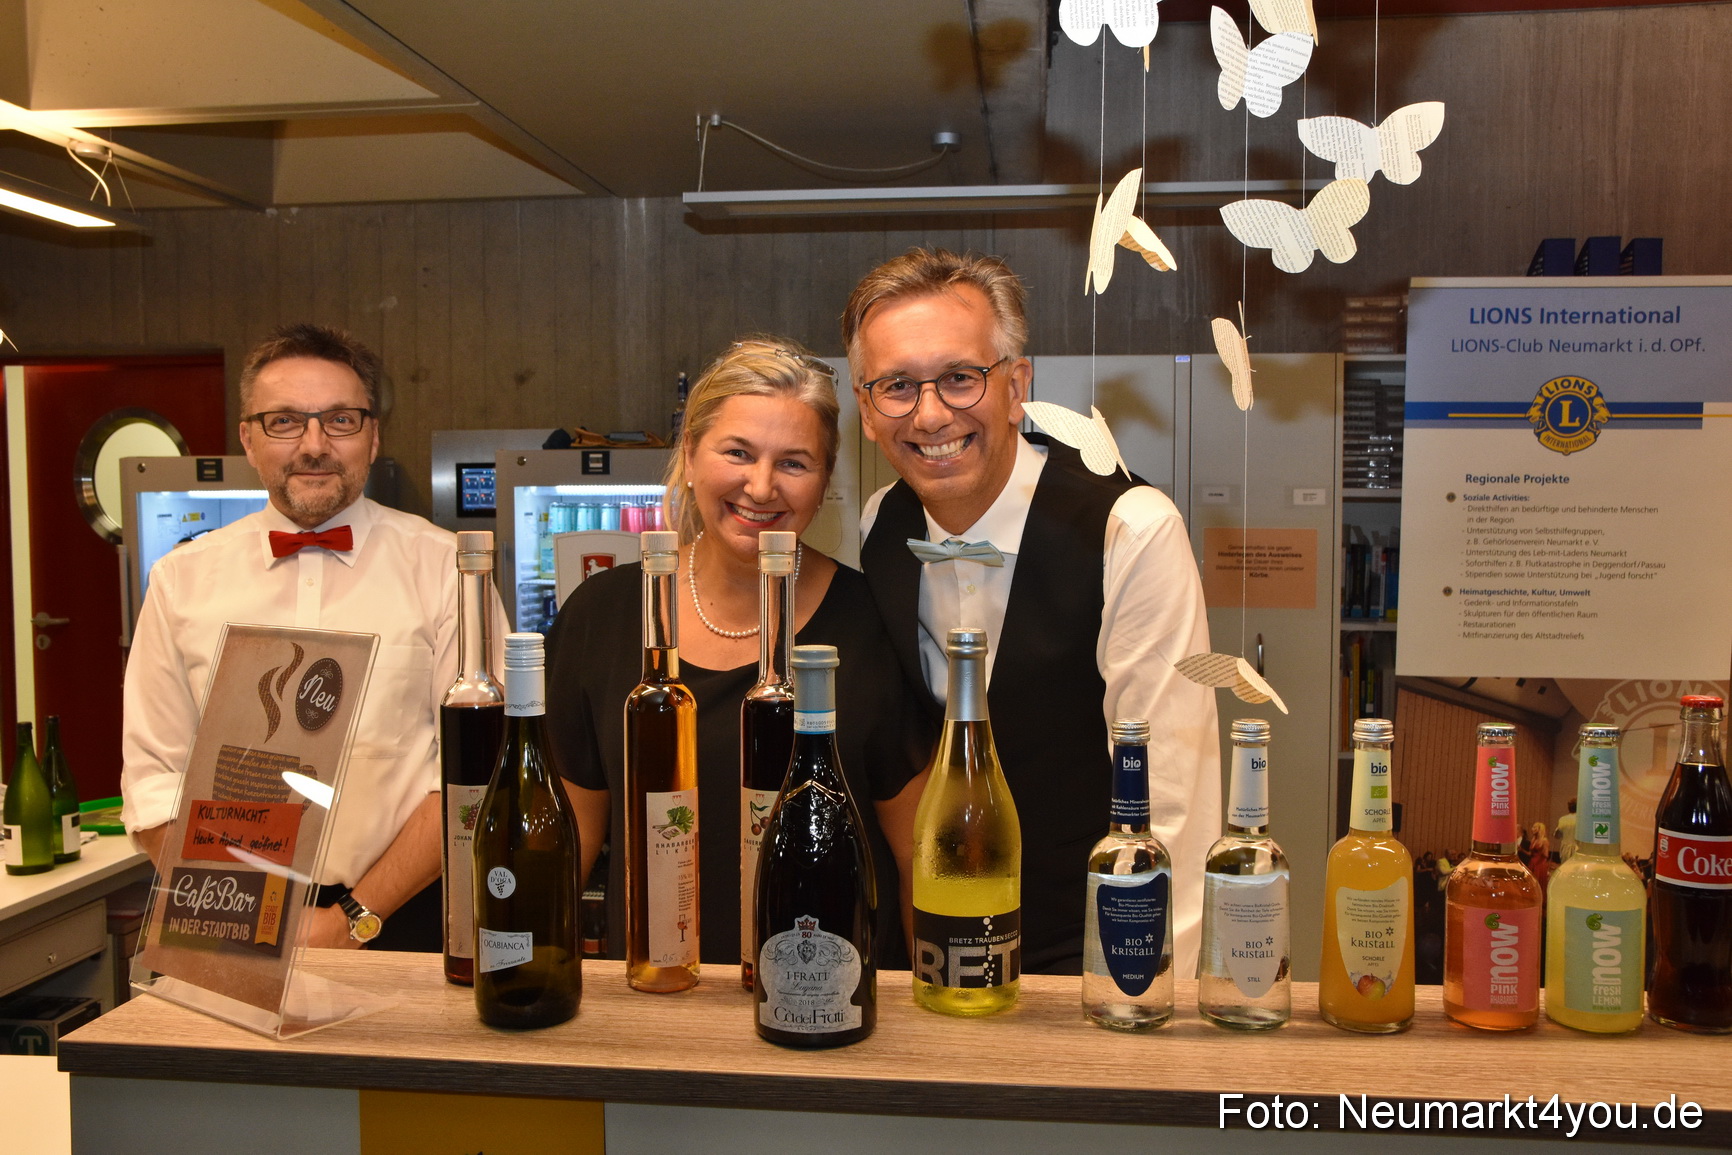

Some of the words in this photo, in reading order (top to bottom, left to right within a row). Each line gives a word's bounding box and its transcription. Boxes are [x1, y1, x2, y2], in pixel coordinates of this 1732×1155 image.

[1470, 307, 1532, 324] LIONS
[1540, 306, 1680, 324] International
[1451, 338, 1543, 352] LIONS-Club
[1549, 338, 1633, 352] Neumarkt
[1639, 339, 1647, 352] i.
[1651, 338, 1666, 352] d.
[1670, 338, 1705, 352] OPf.
[1544, 378, 1594, 397] LIONS
[1559, 400, 1580, 427] L
[1543, 434, 1591, 450] INTERNATIONAL
[1466, 474, 1520, 485] Regionale
[1524, 475, 1570, 486] Projekte
[1468, 505, 1508, 513] Direkthilfen
[1522, 506, 1559, 514] bedürftige
[1621, 506, 1658, 514] Menschen
[1490, 516, 1514, 524] Region
[1467, 527, 1517, 536] Unterstützung
[1535, 528, 1605, 536] Selbsthilfegruppen,
[1466, 549, 1517, 558] Unterstützung
[1466, 560, 1507, 568] Soforthilfen
[1525, 560, 1581, 569] Flutkatastrophe
[1593, 561, 1666, 569] Deggendorf/Passau
[1465, 571, 1502, 579] Stipendien
[1527, 571, 1578, 579] Unterstützung
[1460, 588, 1529, 597] Heimatgeschichte,
[1532, 589, 1557, 597] Kultur,
[1464, 610, 1501, 618] Skulpturen
[1532, 610, 1574, 618] öffentlichen
[1463, 632, 1518, 640] Mitfinanzierung
[300, 674, 335, 712] Neu
[1616, 680, 1718, 712] LION
[1123, 757, 1141, 768] bio
[1251, 758, 1266, 769] bio
[1371, 762, 1388, 773] bio
[1491, 763, 1509, 802] now
[1593, 762, 1611, 802] now
[198, 805, 270, 824] KULTURNACHT:
[193, 830, 214, 845] Heute
[1677, 846, 1732, 876] Coke
[263, 912, 277, 925] BIB
[169, 917, 179, 932] IN
[181, 918, 201, 935] DER
[202, 920, 250, 940] STADTBIB
[1125, 938, 1142, 946] BIO
[1245, 941, 1262, 949] BIO
[1490, 922, 1519, 983] now
[1593, 923, 1622, 983] now
